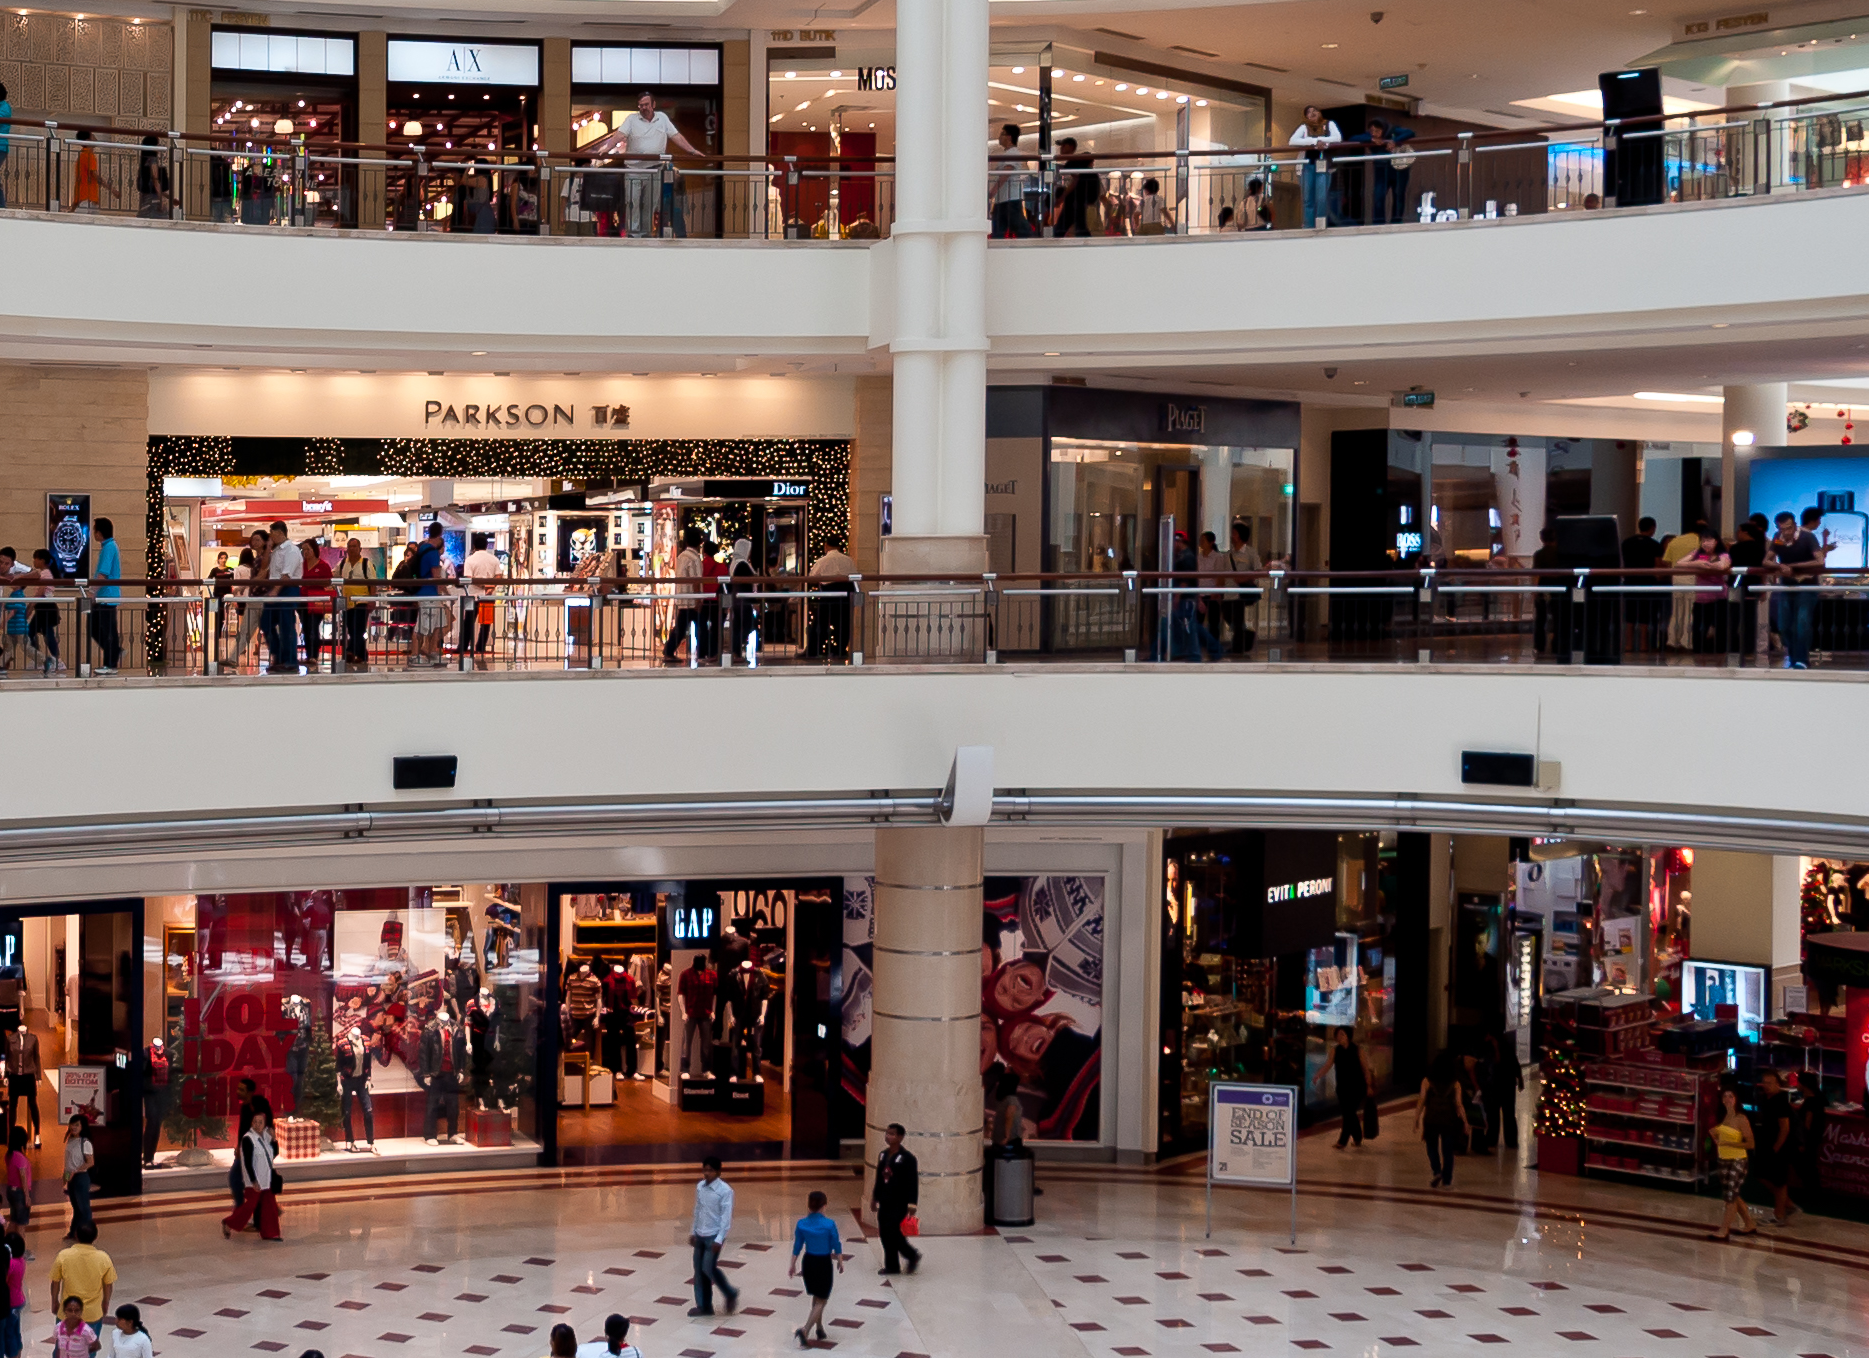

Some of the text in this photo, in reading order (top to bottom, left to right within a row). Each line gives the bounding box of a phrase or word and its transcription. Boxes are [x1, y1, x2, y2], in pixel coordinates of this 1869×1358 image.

[800, 30, 836, 42] BUTIK
[424, 400, 576, 426] PARKSON
[1167, 403, 1208, 433] PIAGET
[772, 481, 807, 497] Dior
[674, 907, 714, 939] GAP
[64, 1077, 99, 1086] BOTTOM
[1231, 1106, 1287, 1120] END OF
[1230, 1118, 1286, 1132] SEASON
[1229, 1129, 1287, 1148] SALE
